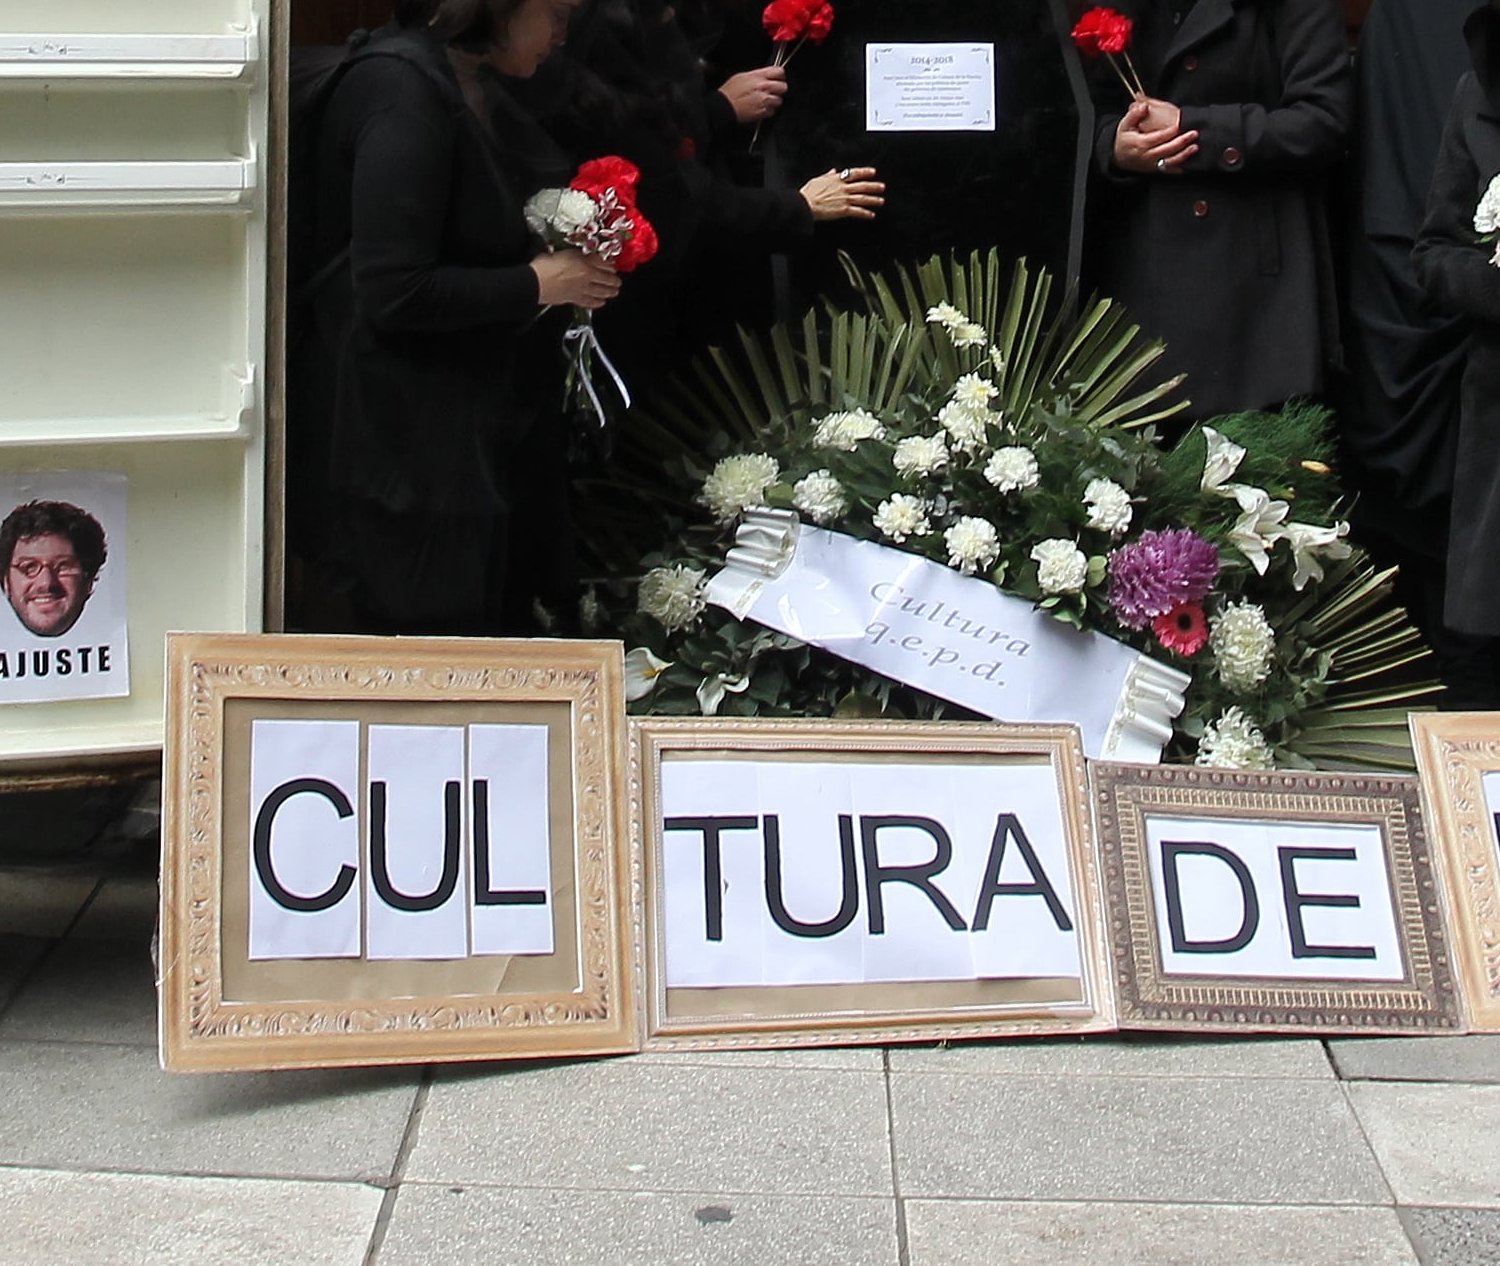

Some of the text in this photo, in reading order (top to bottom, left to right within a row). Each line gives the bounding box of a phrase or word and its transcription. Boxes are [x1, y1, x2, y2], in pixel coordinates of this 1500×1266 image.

[863, 620, 1008, 687] q.e.p.d.
[869, 579, 1031, 659] Cultura
[252, 778, 547, 913] CUL
[662, 811, 1074, 942] TURA
[1159, 839, 1377, 960] DE
